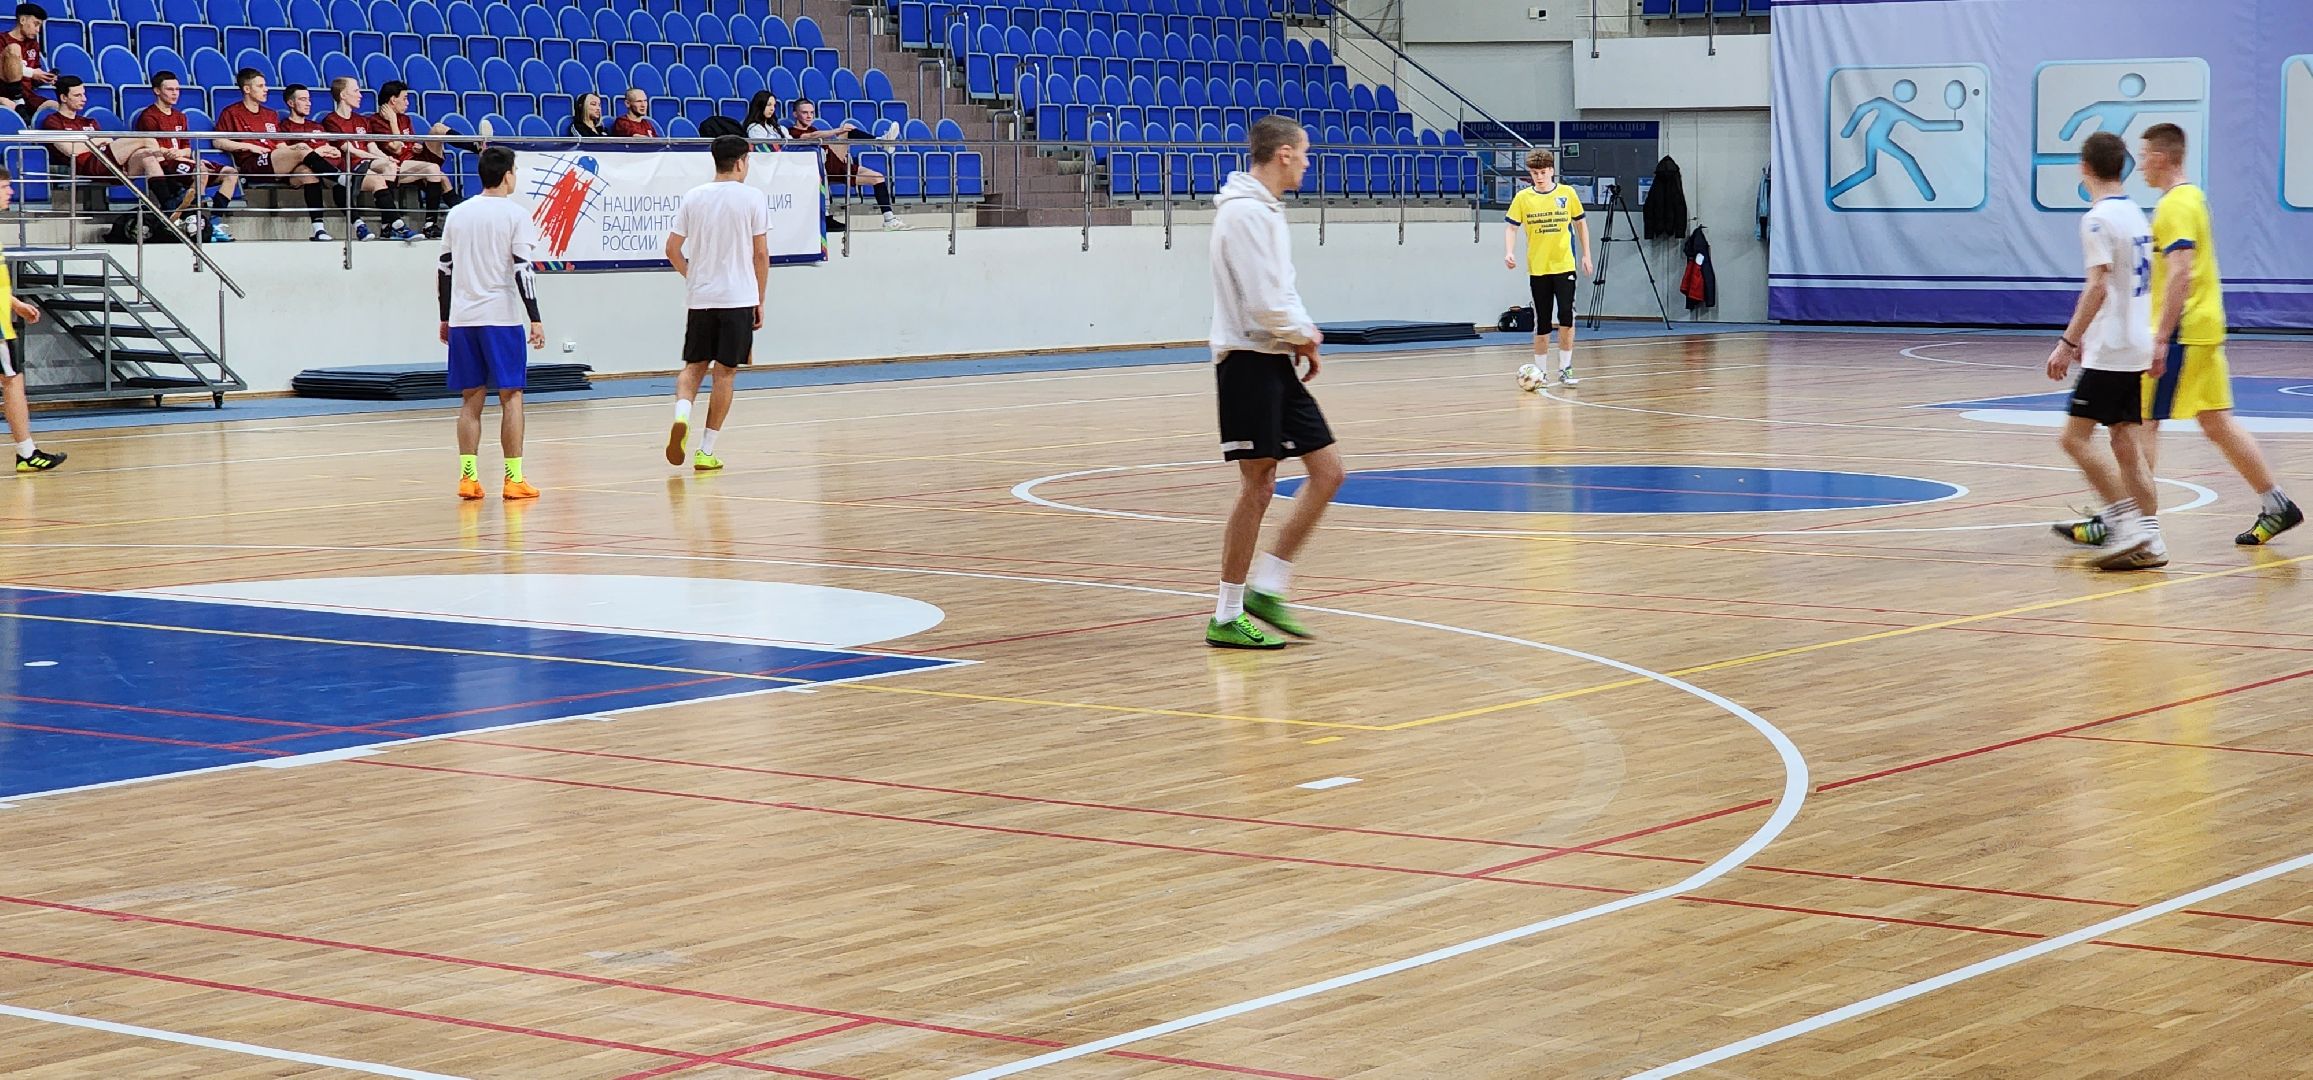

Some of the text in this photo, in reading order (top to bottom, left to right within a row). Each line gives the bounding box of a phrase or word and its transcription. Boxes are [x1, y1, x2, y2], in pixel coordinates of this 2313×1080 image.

[1470, 123, 1542, 132] ИНФОМАЦИЯ
[1571, 122, 1647, 132] ИНФОРМАЦИЯ
[603, 195, 683, 214] НАЦИОНАЛ
[602, 235, 658, 251] РОССИИ
